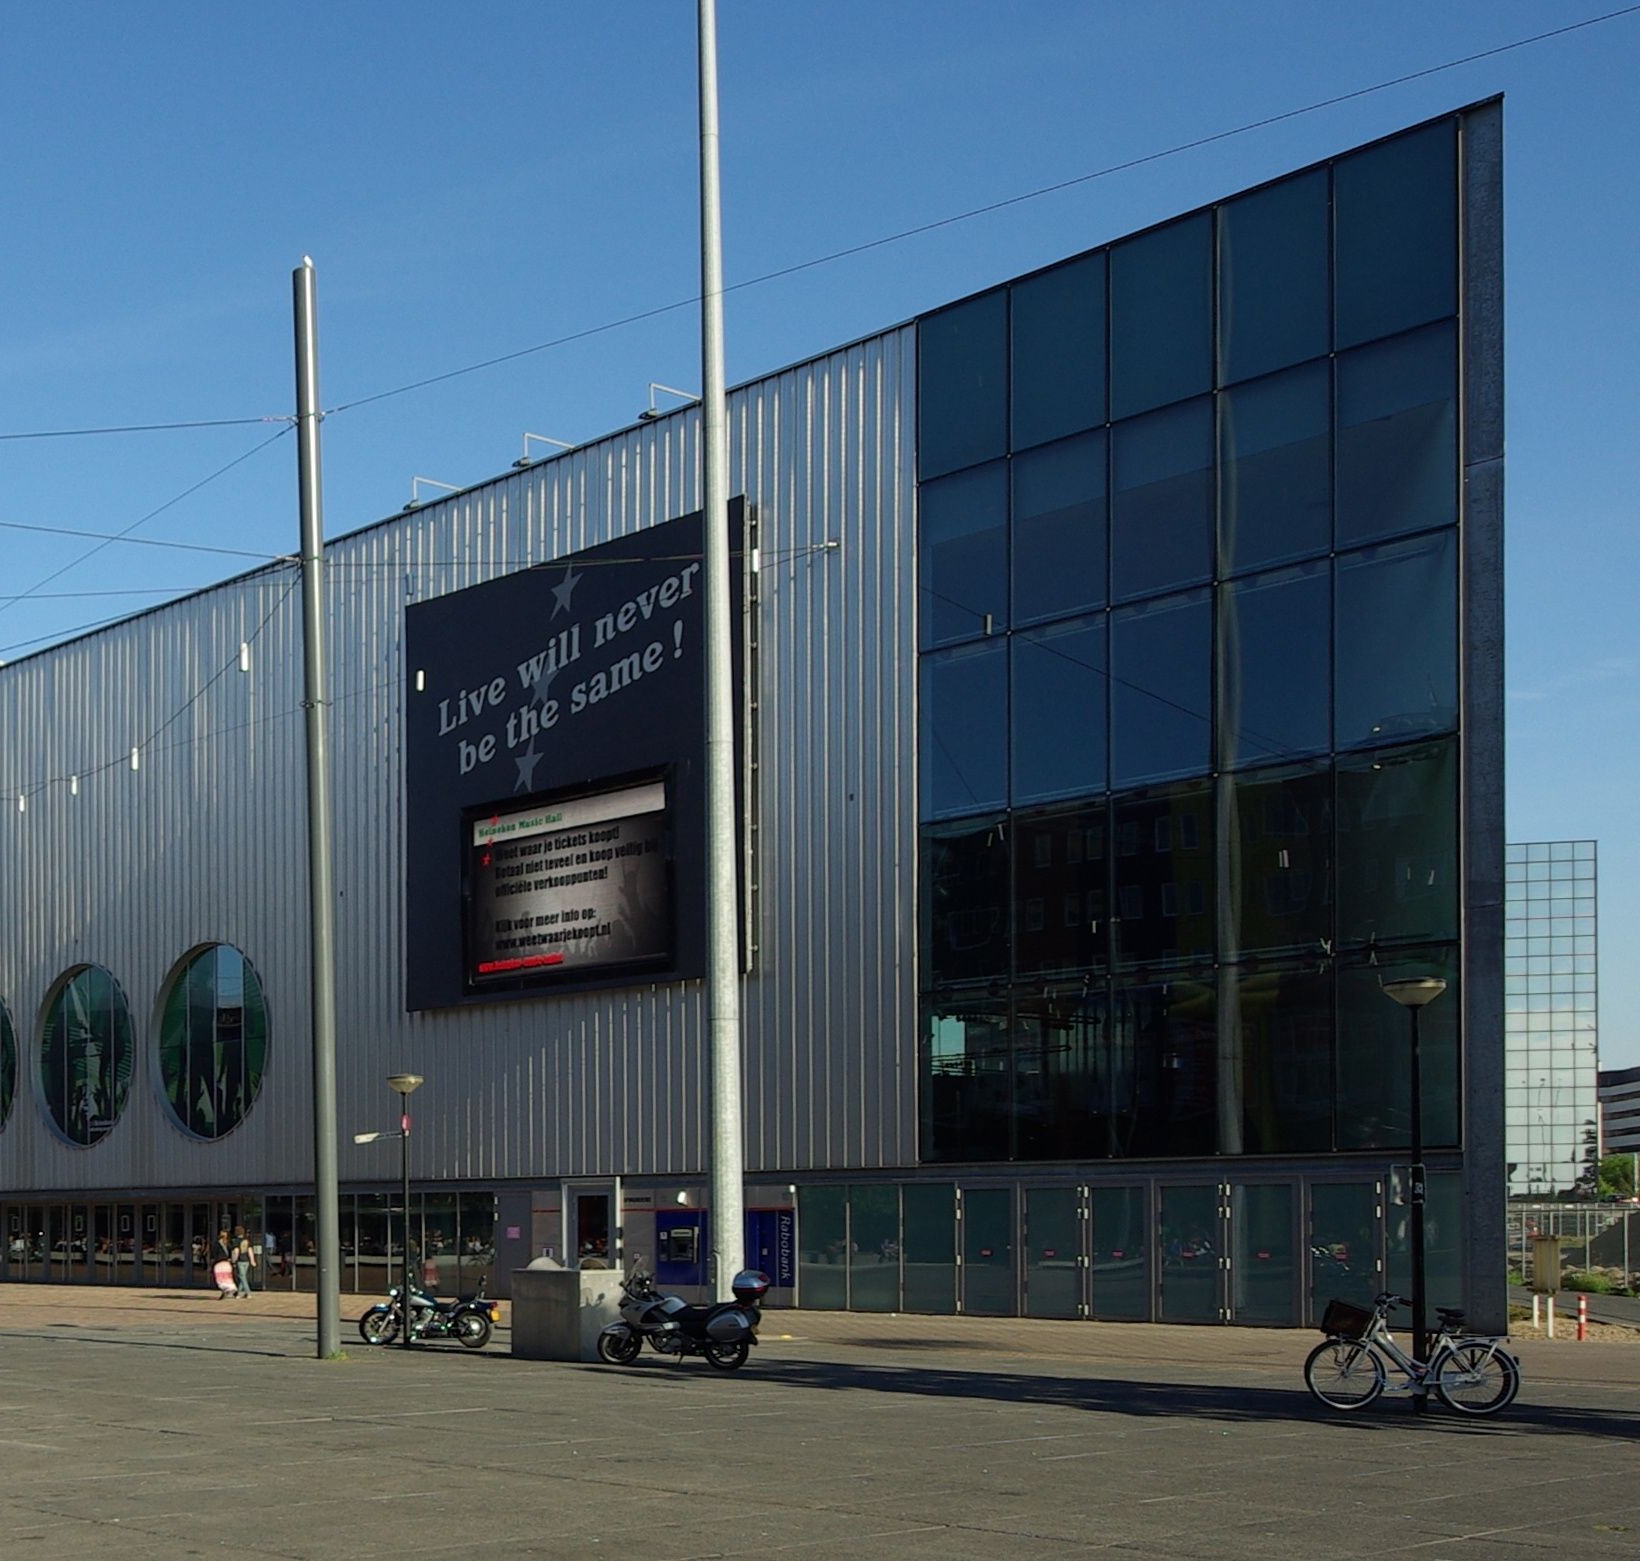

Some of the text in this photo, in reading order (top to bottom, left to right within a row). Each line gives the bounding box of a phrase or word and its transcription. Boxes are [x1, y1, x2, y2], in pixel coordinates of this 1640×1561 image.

[438, 562, 700, 736] Live will never
[459, 734, 497, 775] be
[505, 701, 559, 750] the
[570, 641, 664, 715] same
[478, 811, 563, 838] Heineken Music Hall
[520, 842, 542, 857] waar
[544, 839, 553, 854] je
[554, 833, 587, 849] tickets
[525, 859, 543, 875] niet
[545, 852, 574, 871] teveel
[575, 852, 588, 867] en
[589, 847, 613, 864] koop
[514, 916, 534, 931] voor
[535, 912, 560, 928] meer
[560, 907, 579, 924] info
[780, 1215, 792, 1280] Rabobank
